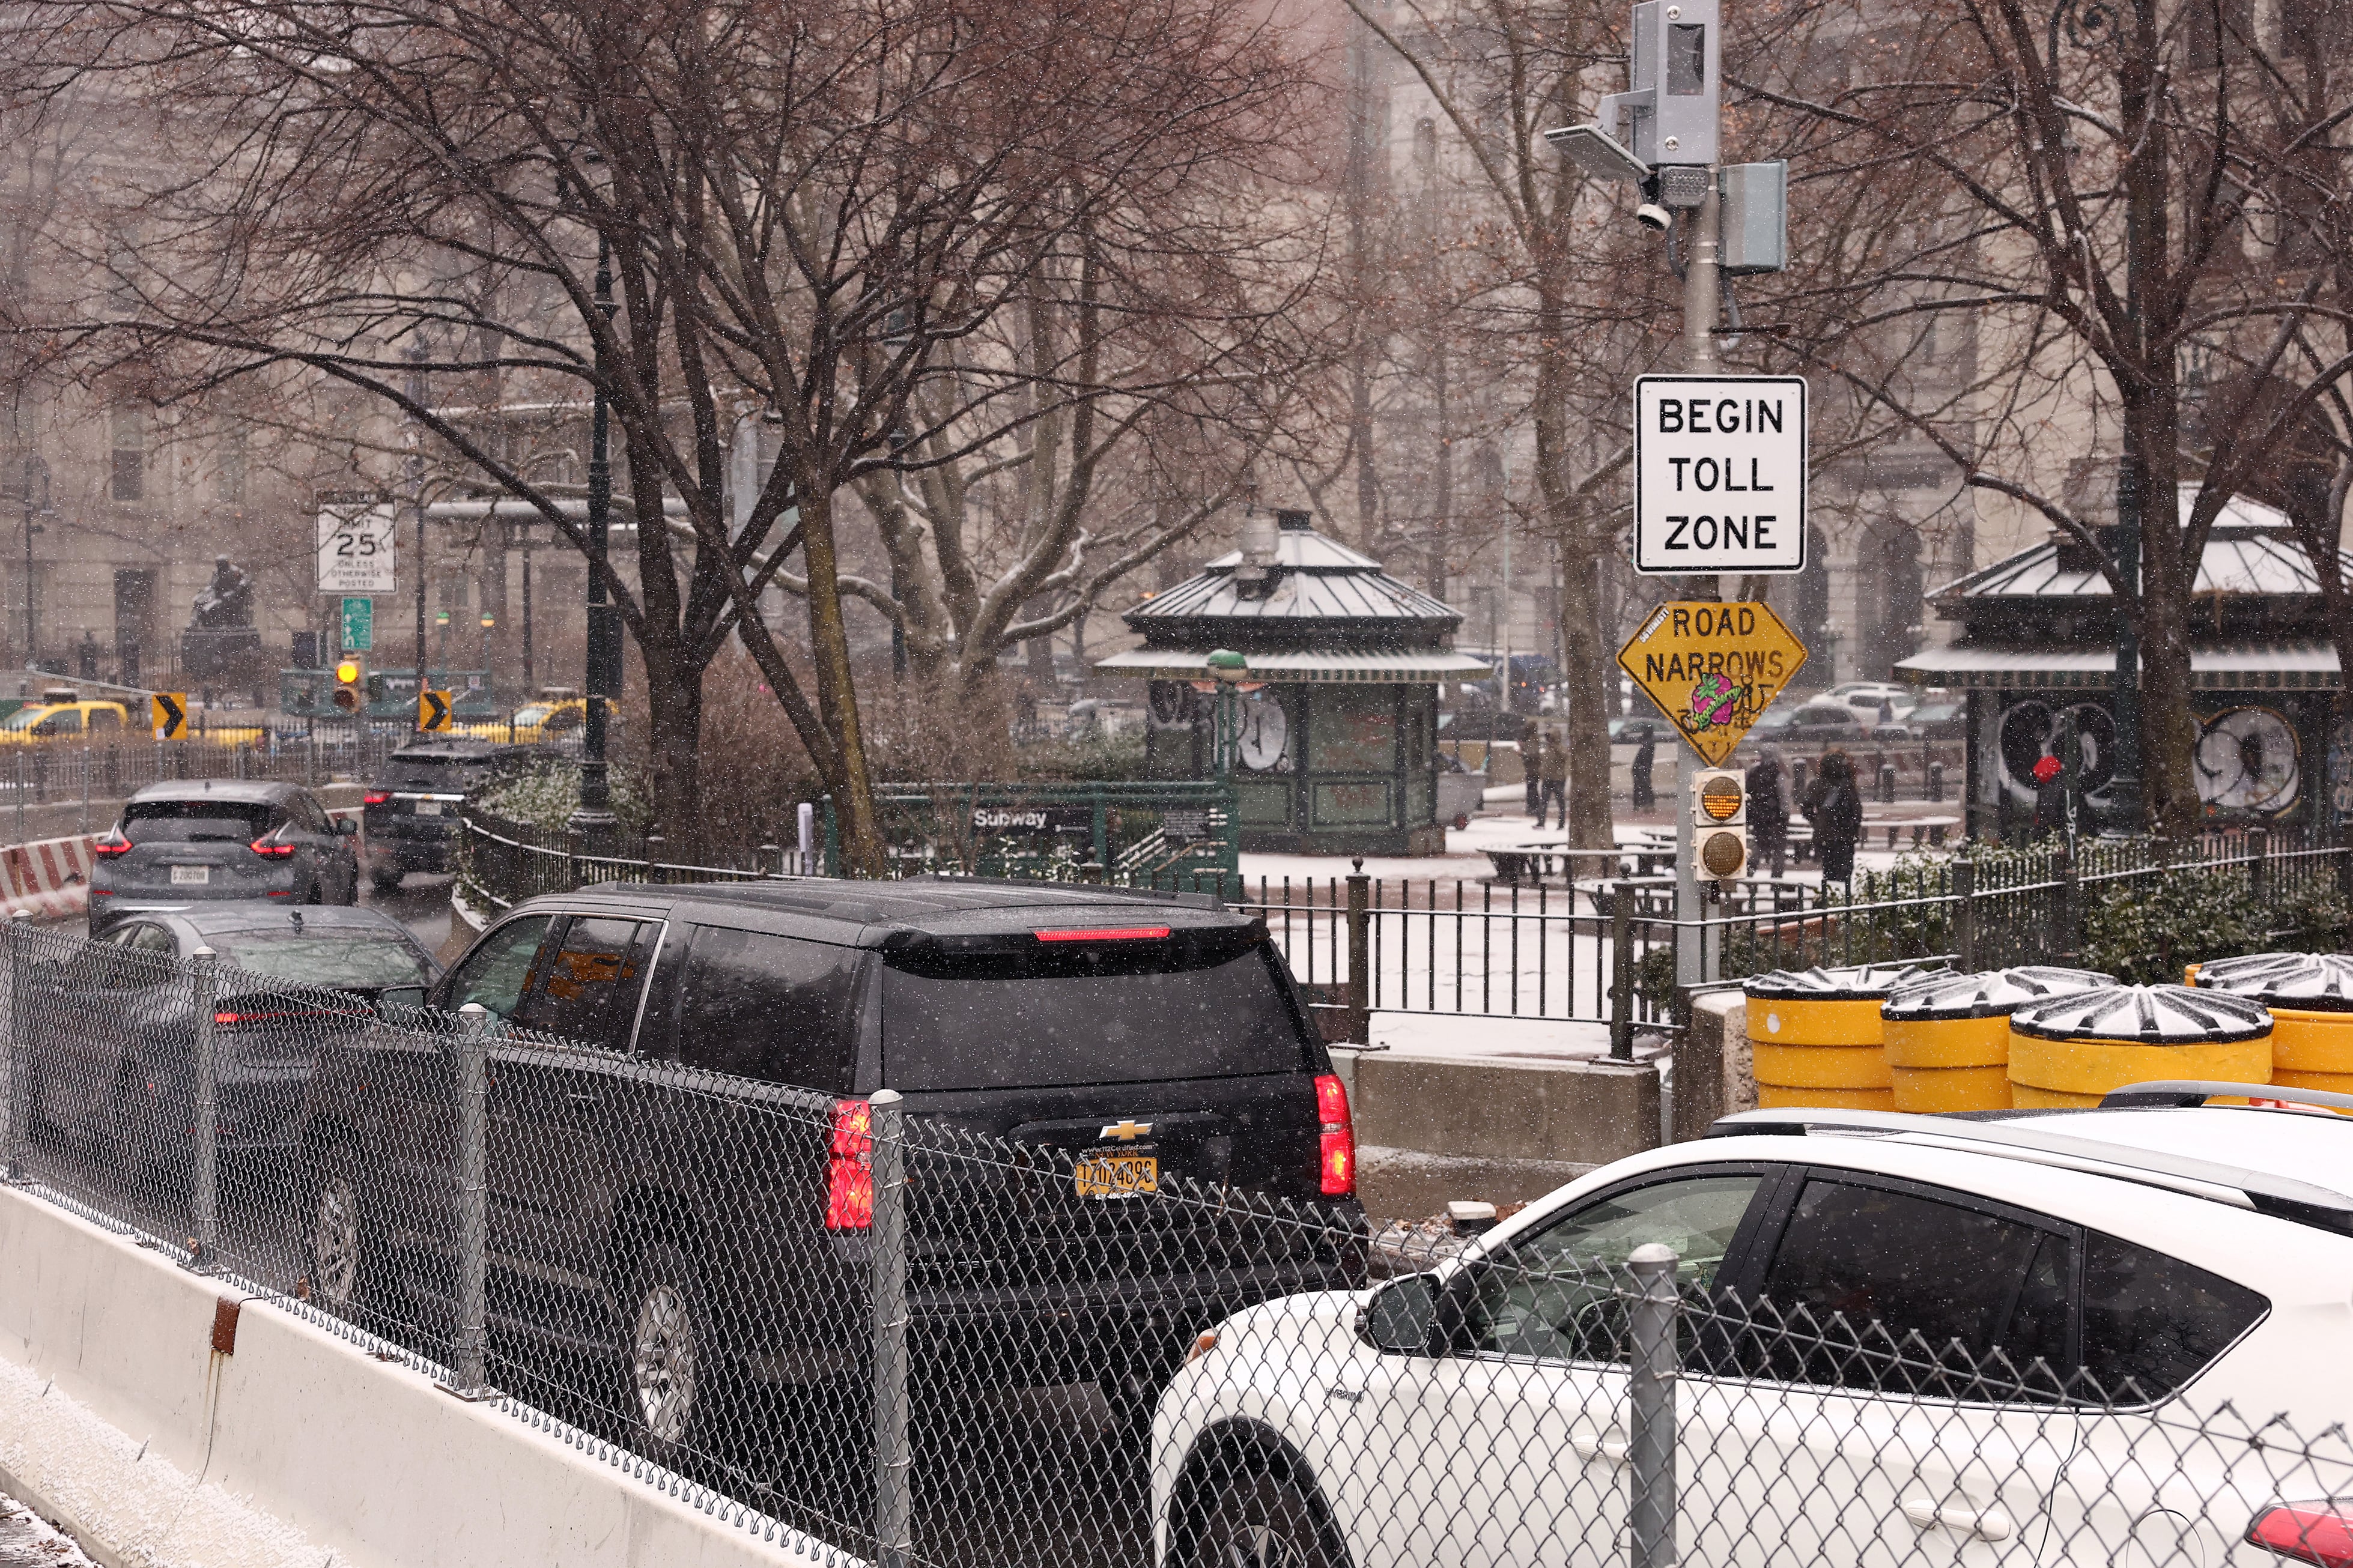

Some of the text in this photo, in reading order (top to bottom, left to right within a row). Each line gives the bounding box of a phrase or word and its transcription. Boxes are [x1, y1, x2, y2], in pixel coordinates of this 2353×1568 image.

[1660, 399, 1782, 433] BEGIN
[1668, 457, 1774, 491] TOLL
[337, 533, 376, 555] 25
[1665, 515, 1776, 549] ZONE
[1673, 607, 1755, 637] ROAD
[1646, 650, 1784, 682] NARROWS
[973, 809, 1048, 829] Subway
